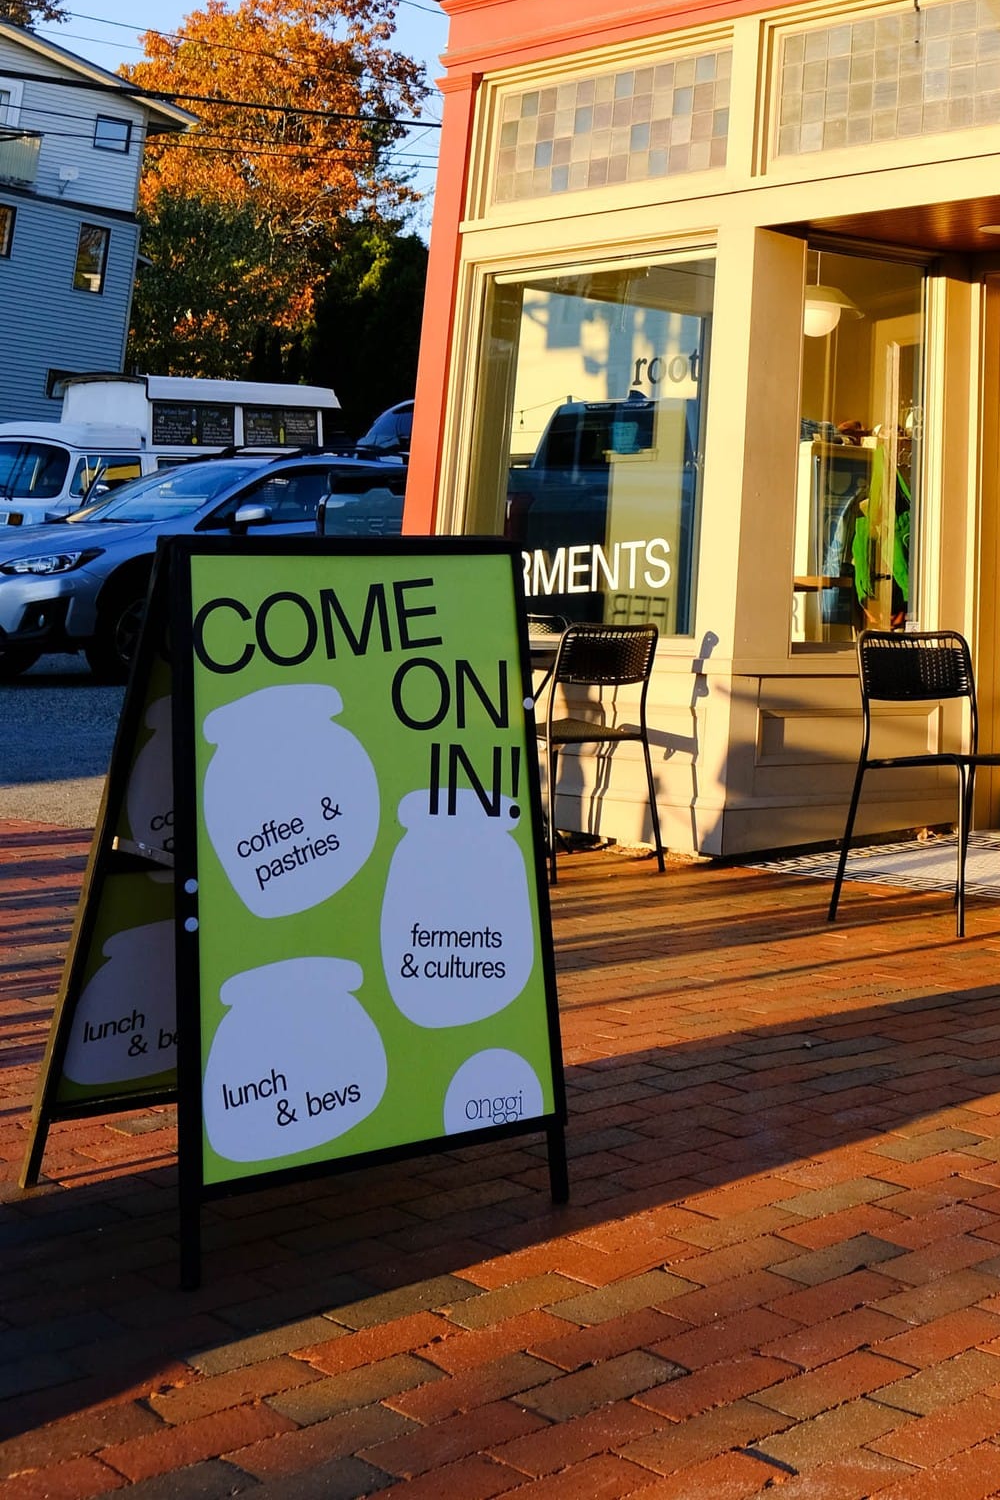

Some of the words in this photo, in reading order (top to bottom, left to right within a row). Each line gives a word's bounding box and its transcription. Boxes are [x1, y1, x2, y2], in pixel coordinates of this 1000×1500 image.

[194, 578, 442, 674] COME
[391, 658, 508, 730] ON
[429, 744, 521, 819] IN!
[236, 812, 305, 860] coffee
[320, 797, 343, 821] &
[255, 832, 341, 890] pastries
[410, 924, 502, 949] ferments
[400, 954, 420, 979] &
[424, 955, 506, 980] cultures
[83, 1009, 146, 1044] lunch
[127, 1034, 148, 1057] &
[222, 1069, 288, 1111] lunch
[276, 1100, 298, 1127] &
[306, 1083, 362, 1118] bevs
[465, 1090, 524, 1124] onggi
